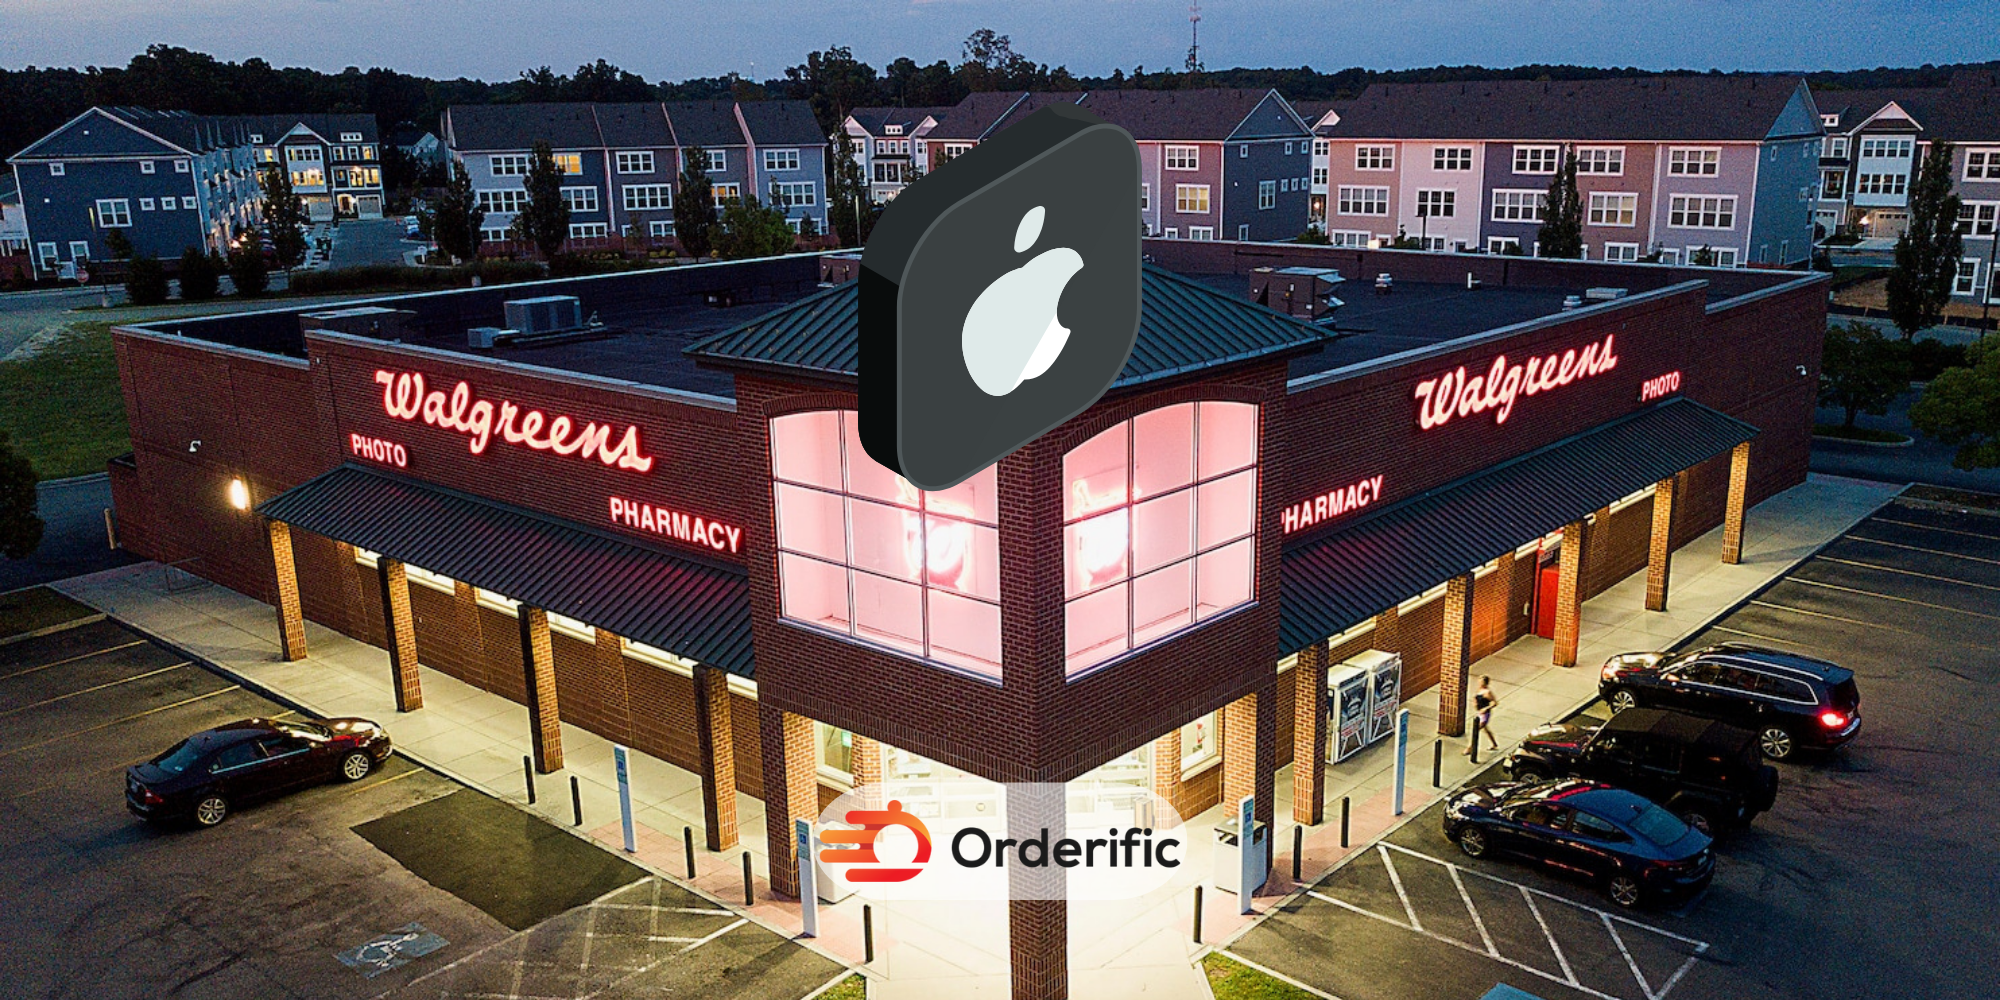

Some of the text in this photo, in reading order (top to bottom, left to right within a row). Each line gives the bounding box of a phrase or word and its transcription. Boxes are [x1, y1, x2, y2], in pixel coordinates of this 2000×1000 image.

[1414, 334, 1618, 430] Walgreens
[1641, 371, 1680, 401] PHOTO
[375, 369, 653, 472] Walgreens
[350, 433, 407, 467] PHOTO
[609, 496, 741, 553] PHARMACY
[1281, 474, 1383, 534] HARMACY
